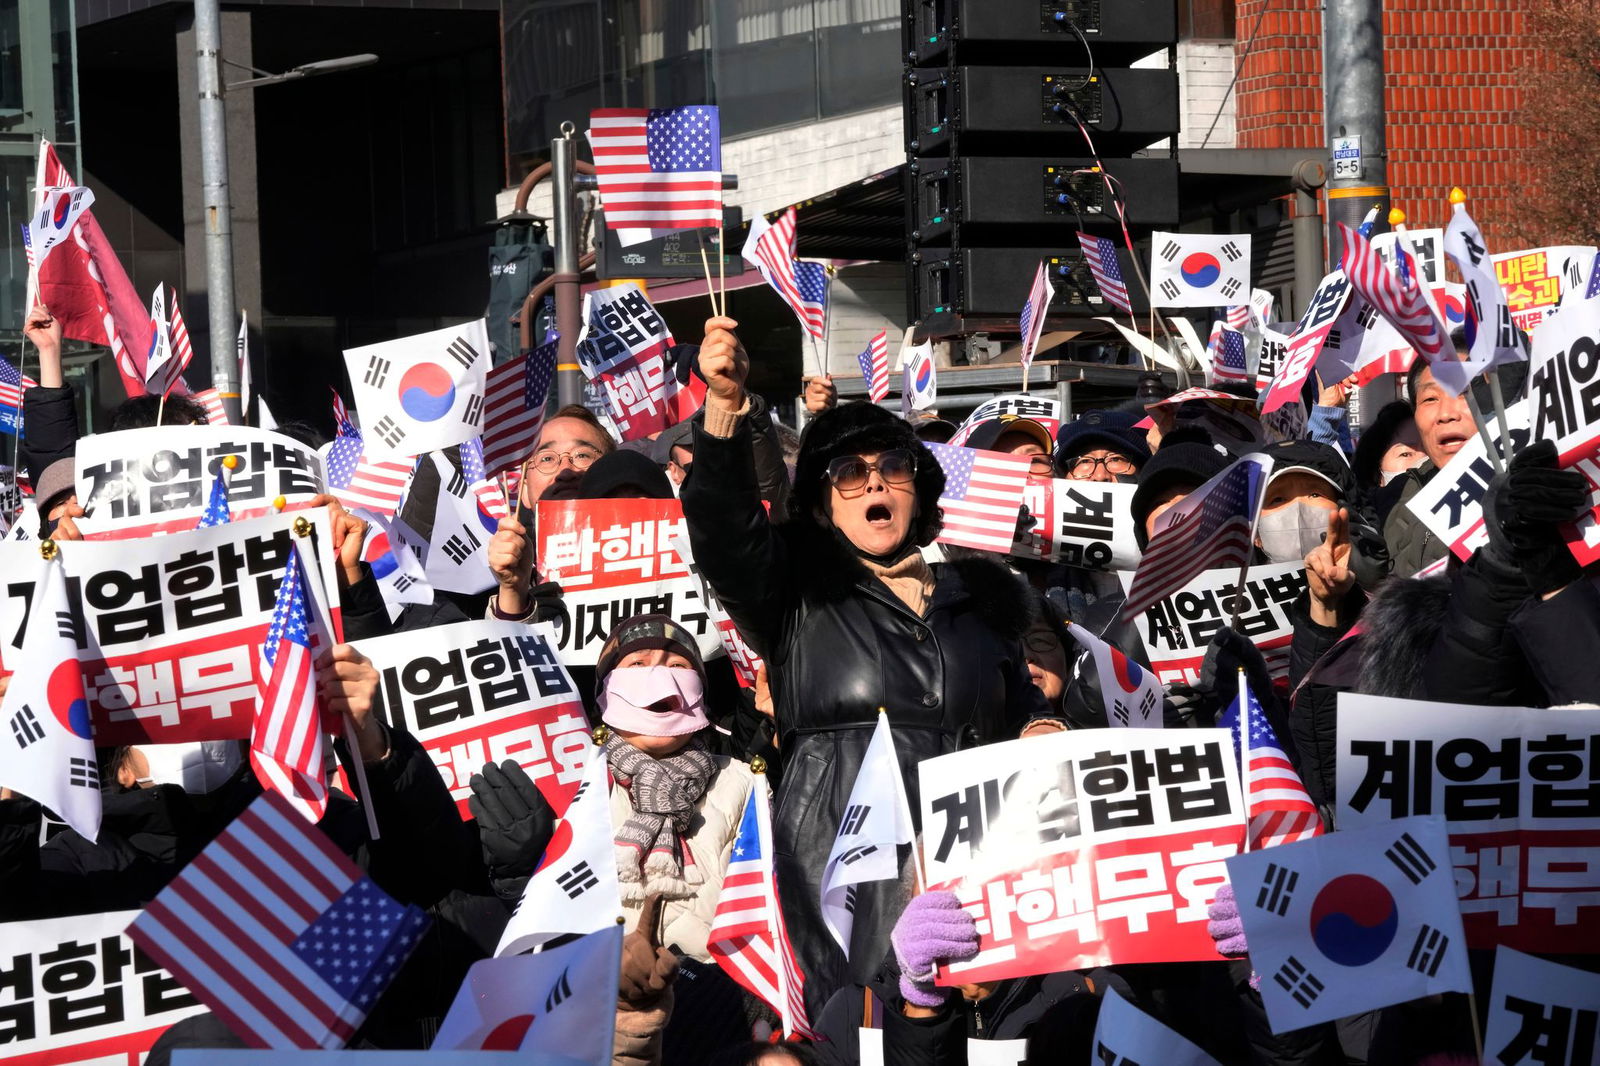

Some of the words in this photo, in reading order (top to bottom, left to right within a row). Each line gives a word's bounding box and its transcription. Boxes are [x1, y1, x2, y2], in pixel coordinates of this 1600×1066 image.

[1336, 160, 1358, 174] 5-5
[1497, 253, 1547, 285] 내란
[1508, 278, 1559, 310] 수괴
[82, 442, 326, 519] 계엄합법
[82, 642, 263, 727] 핵무
[932, 742, 1232, 863] 계엄합법
